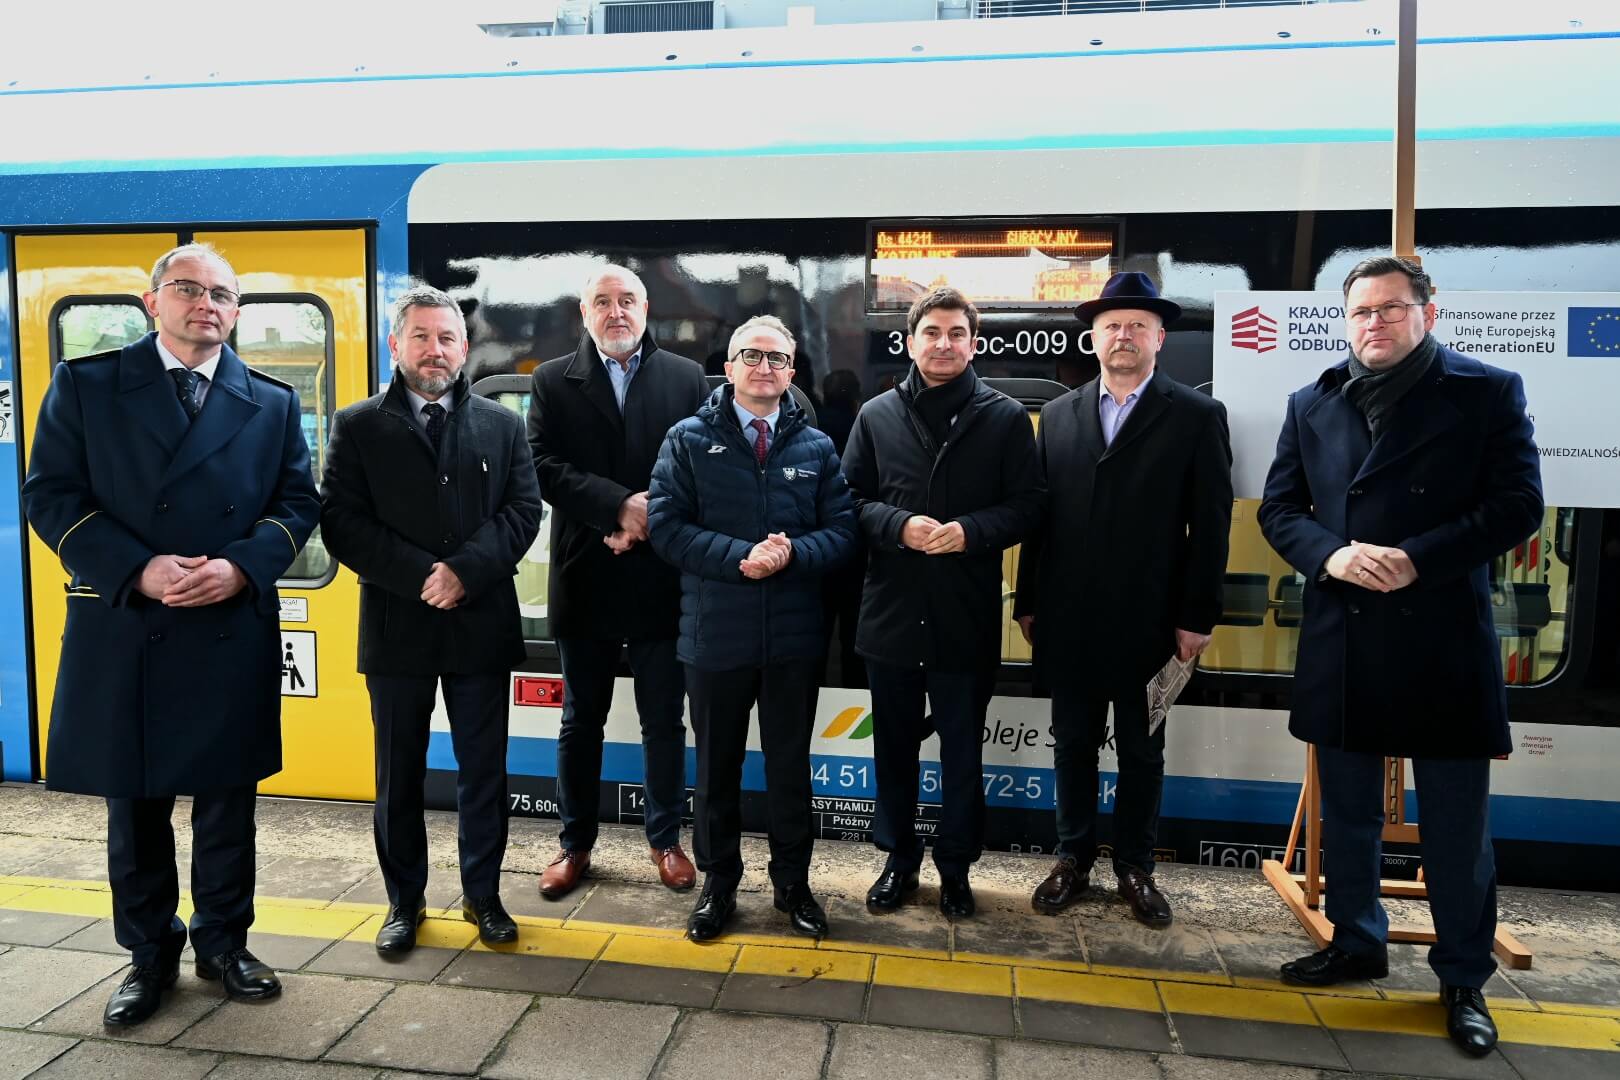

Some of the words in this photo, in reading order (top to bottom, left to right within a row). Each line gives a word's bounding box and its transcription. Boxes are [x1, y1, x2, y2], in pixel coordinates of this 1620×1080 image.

[898, 231, 932, 247] 44211
[1521, 311, 1556, 323] przez
[1288, 322, 1329, 335] PLAN
[1455, 325, 1483, 338] Unię
[1487, 325, 1556, 339] Europejską
[982, 719, 1039, 753] oleje
[839, 764, 868, 788] 51
[811, 800, 832, 810] ASY
[835, 801, 875, 813] HAMUJ
[833, 815, 871, 829] Próżny
